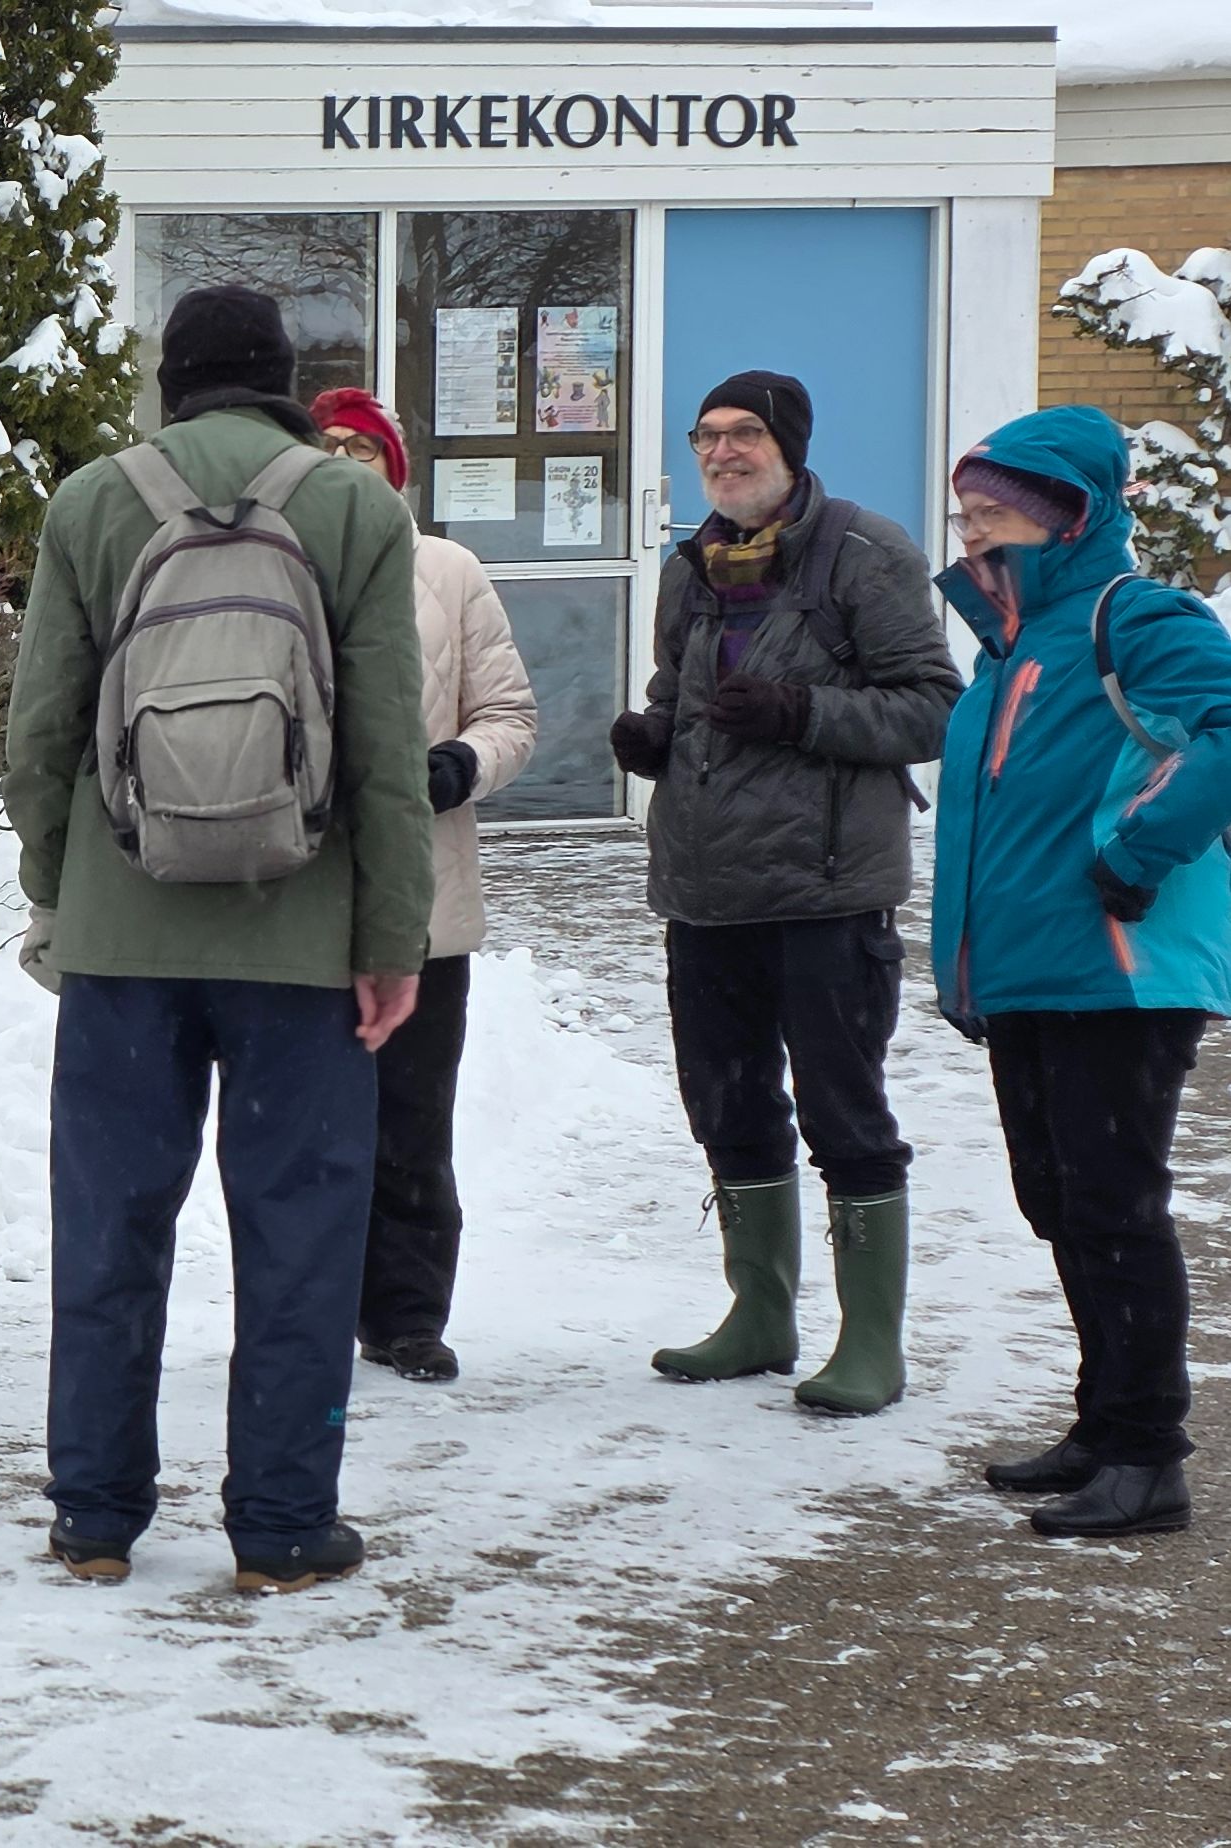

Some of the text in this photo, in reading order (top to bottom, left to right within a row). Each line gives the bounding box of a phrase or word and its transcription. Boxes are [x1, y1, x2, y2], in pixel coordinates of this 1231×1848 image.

[322, 93, 799, 149] KIRKEKONTOR
[583, 465, 599, 477] 20
[583, 477, 598, 489] 26
